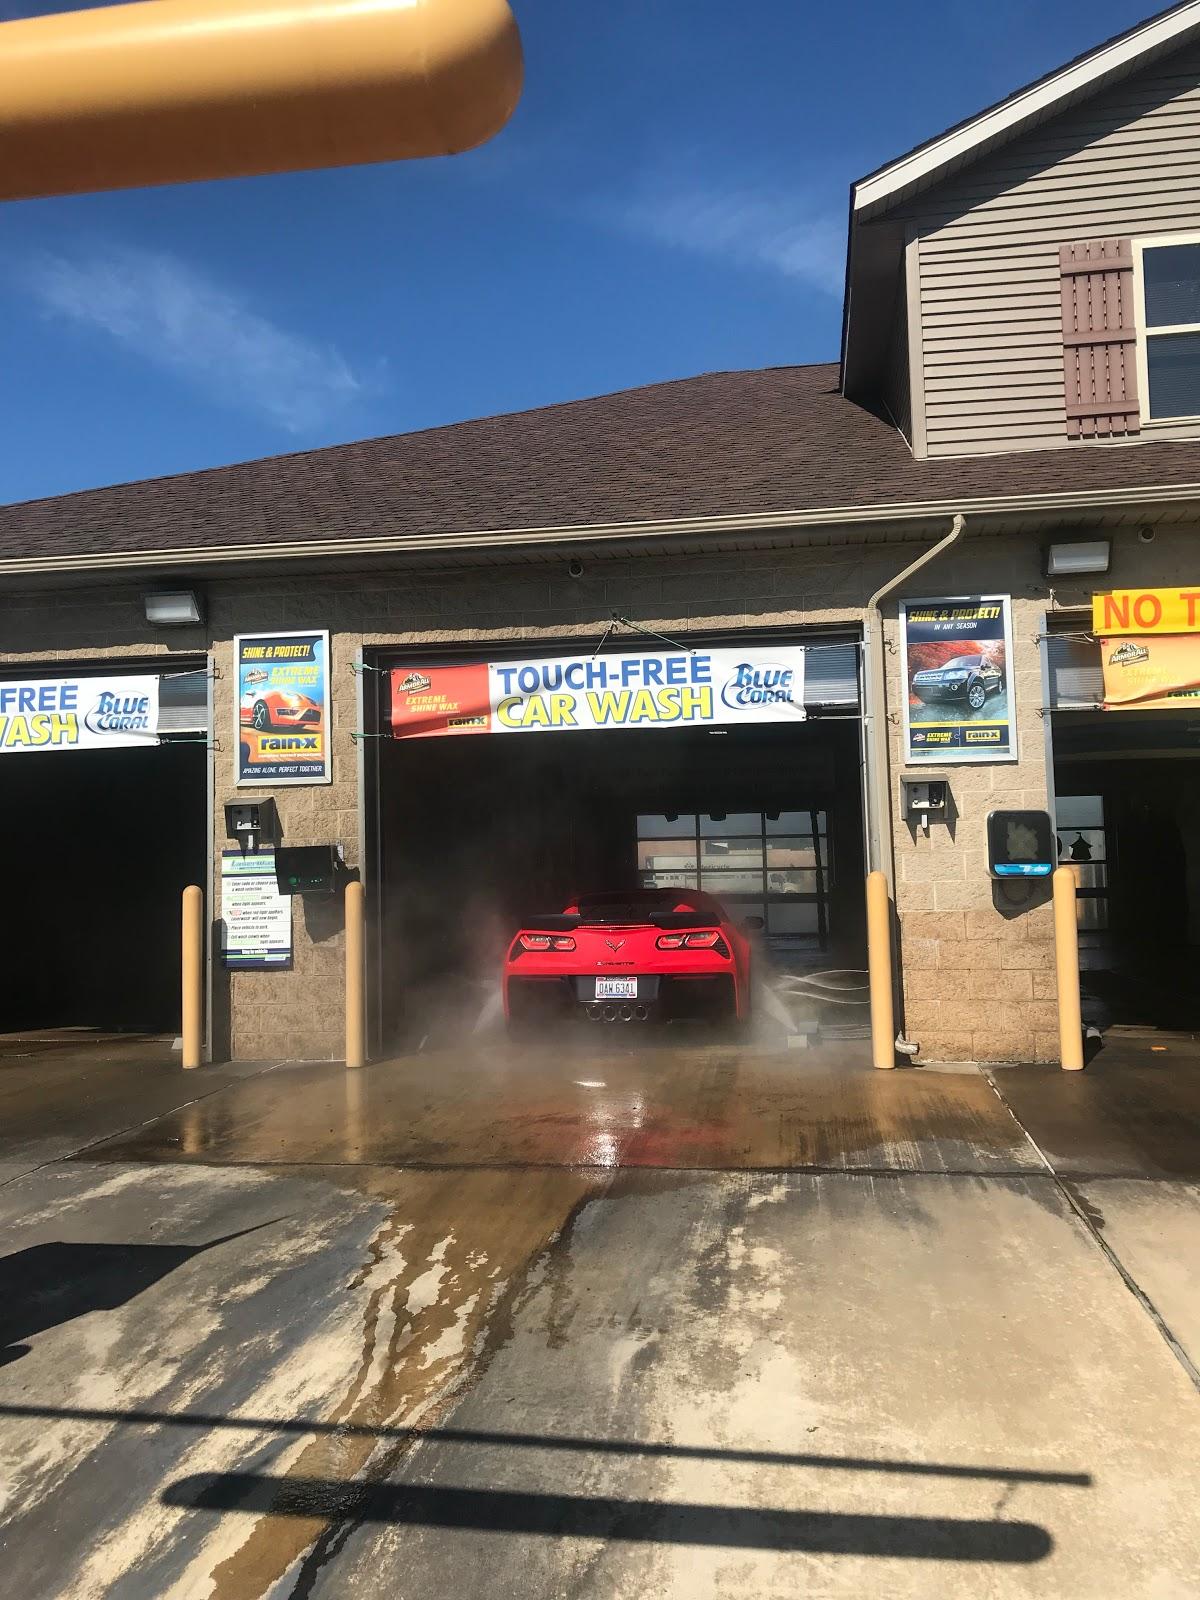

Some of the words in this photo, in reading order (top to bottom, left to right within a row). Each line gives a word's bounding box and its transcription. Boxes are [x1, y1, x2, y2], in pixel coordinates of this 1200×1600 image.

[908, 611, 938, 623] SHINE
[950, 607, 1000, 620] PROTECT!
[1103, 594, 1162, 629] NO
[956, 622, 977, 630] SEASON
[242, 646, 266, 659] SHINE
[265, 646, 274, 658] &
[273, 644, 311, 657] PROTECT!
[497, 655, 712, 695] TOUCH-FREE
[729, 663, 793, 689] BLUE
[1, 685, 78, 713] FREE
[94, 691, 149, 715] BLUE
[405, 695, 447, 705] EXTREME
[735, 686, 794, 705] CORAL
[409, 704, 437, 713] SHINE
[438, 702, 458, 711] WAX
[497, 694, 579, 729] CAR
[585, 685, 714, 724] WASH
[97, 713, 149, 731] CORAL
[278, 765, 298, 773] PERFECT
[615, 982, 634, 994] 6341
